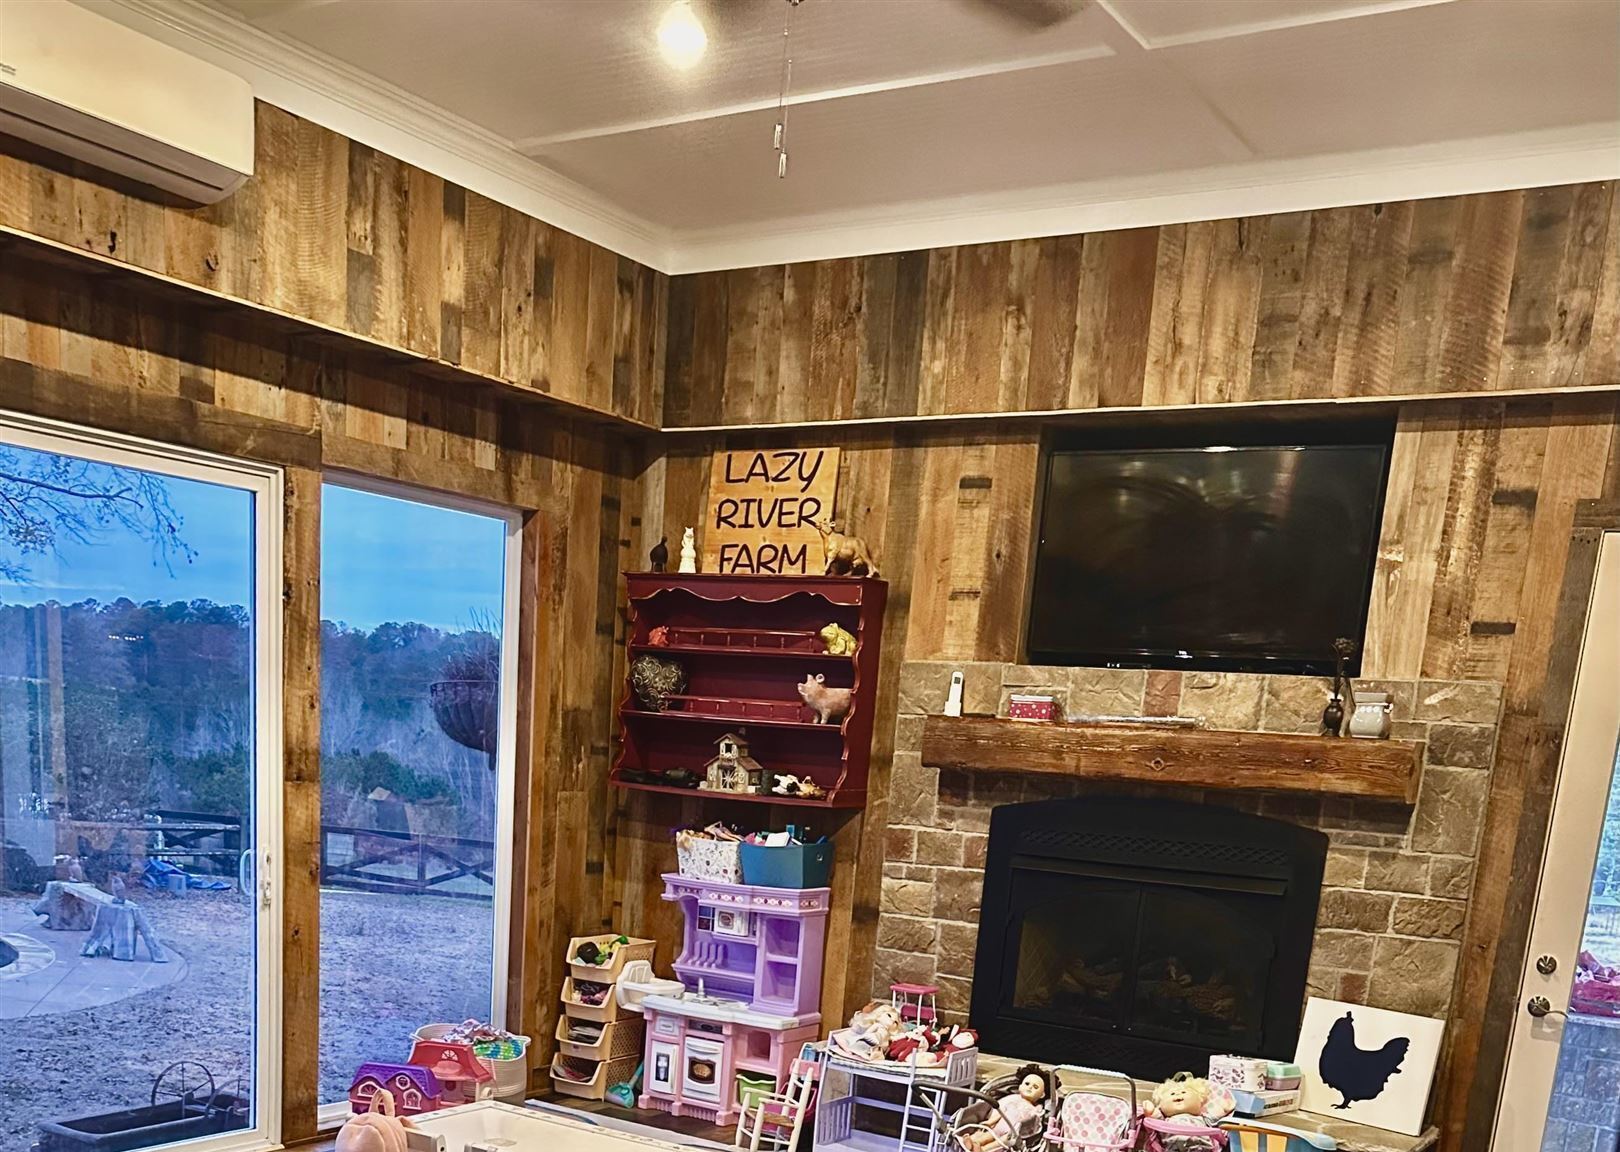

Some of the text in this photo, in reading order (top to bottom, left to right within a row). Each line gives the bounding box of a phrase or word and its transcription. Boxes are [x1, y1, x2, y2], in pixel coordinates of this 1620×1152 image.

[725, 450, 824, 493] LAZY
[716, 497, 822, 530] RIVER
[719, 543, 807, 574] FARM
